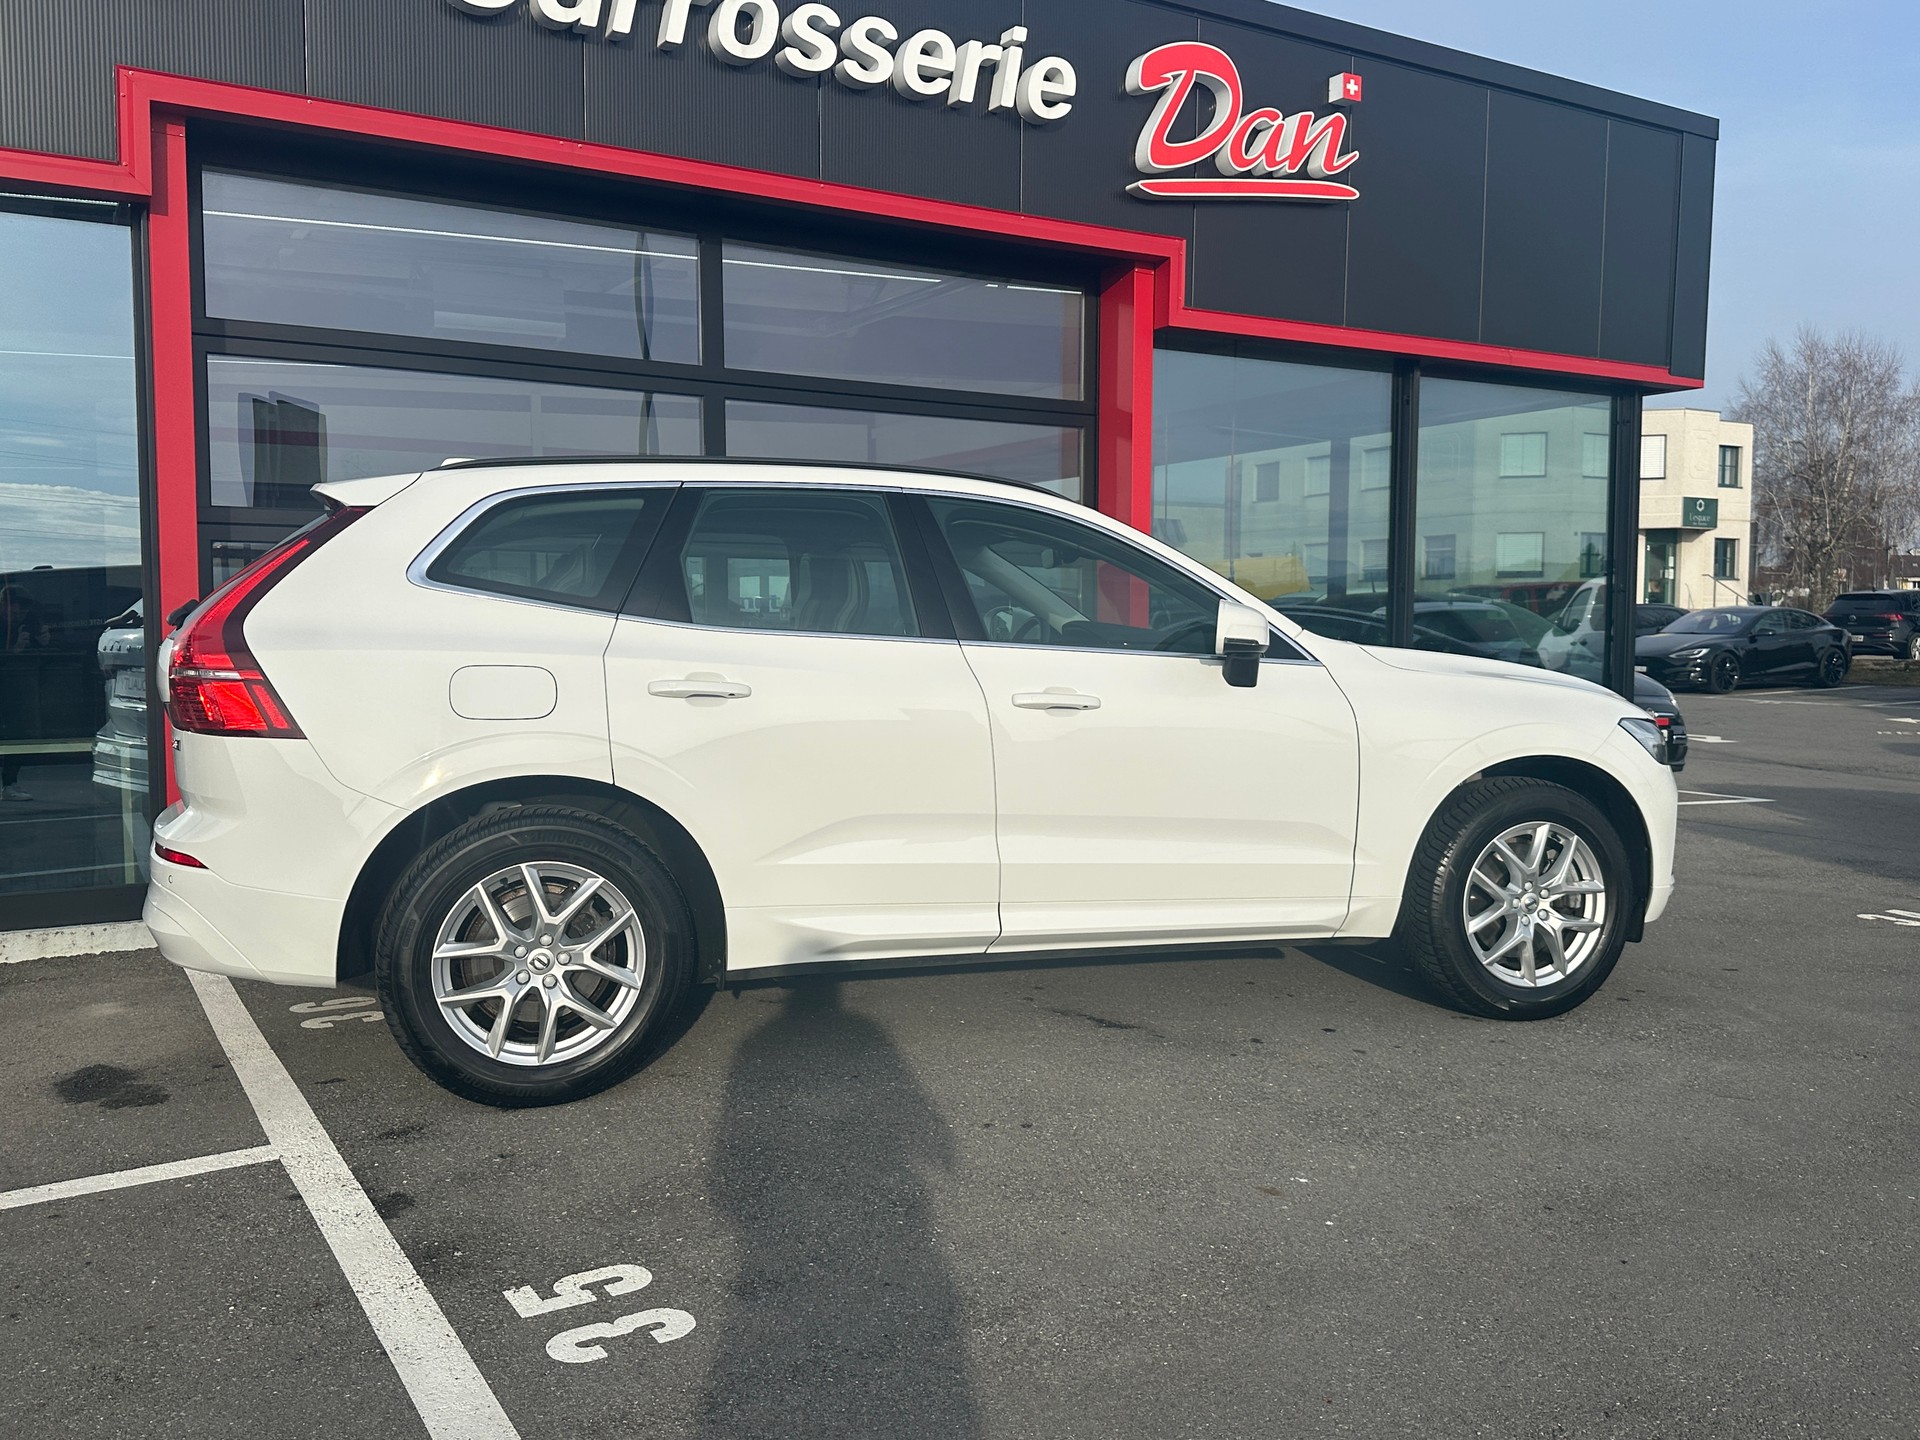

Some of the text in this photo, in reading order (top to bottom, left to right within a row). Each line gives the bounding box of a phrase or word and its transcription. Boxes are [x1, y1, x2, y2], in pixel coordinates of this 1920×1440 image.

[450, 0, 1360, 179] rosserie Dan
[502, 1264, 697, 1363] 35
